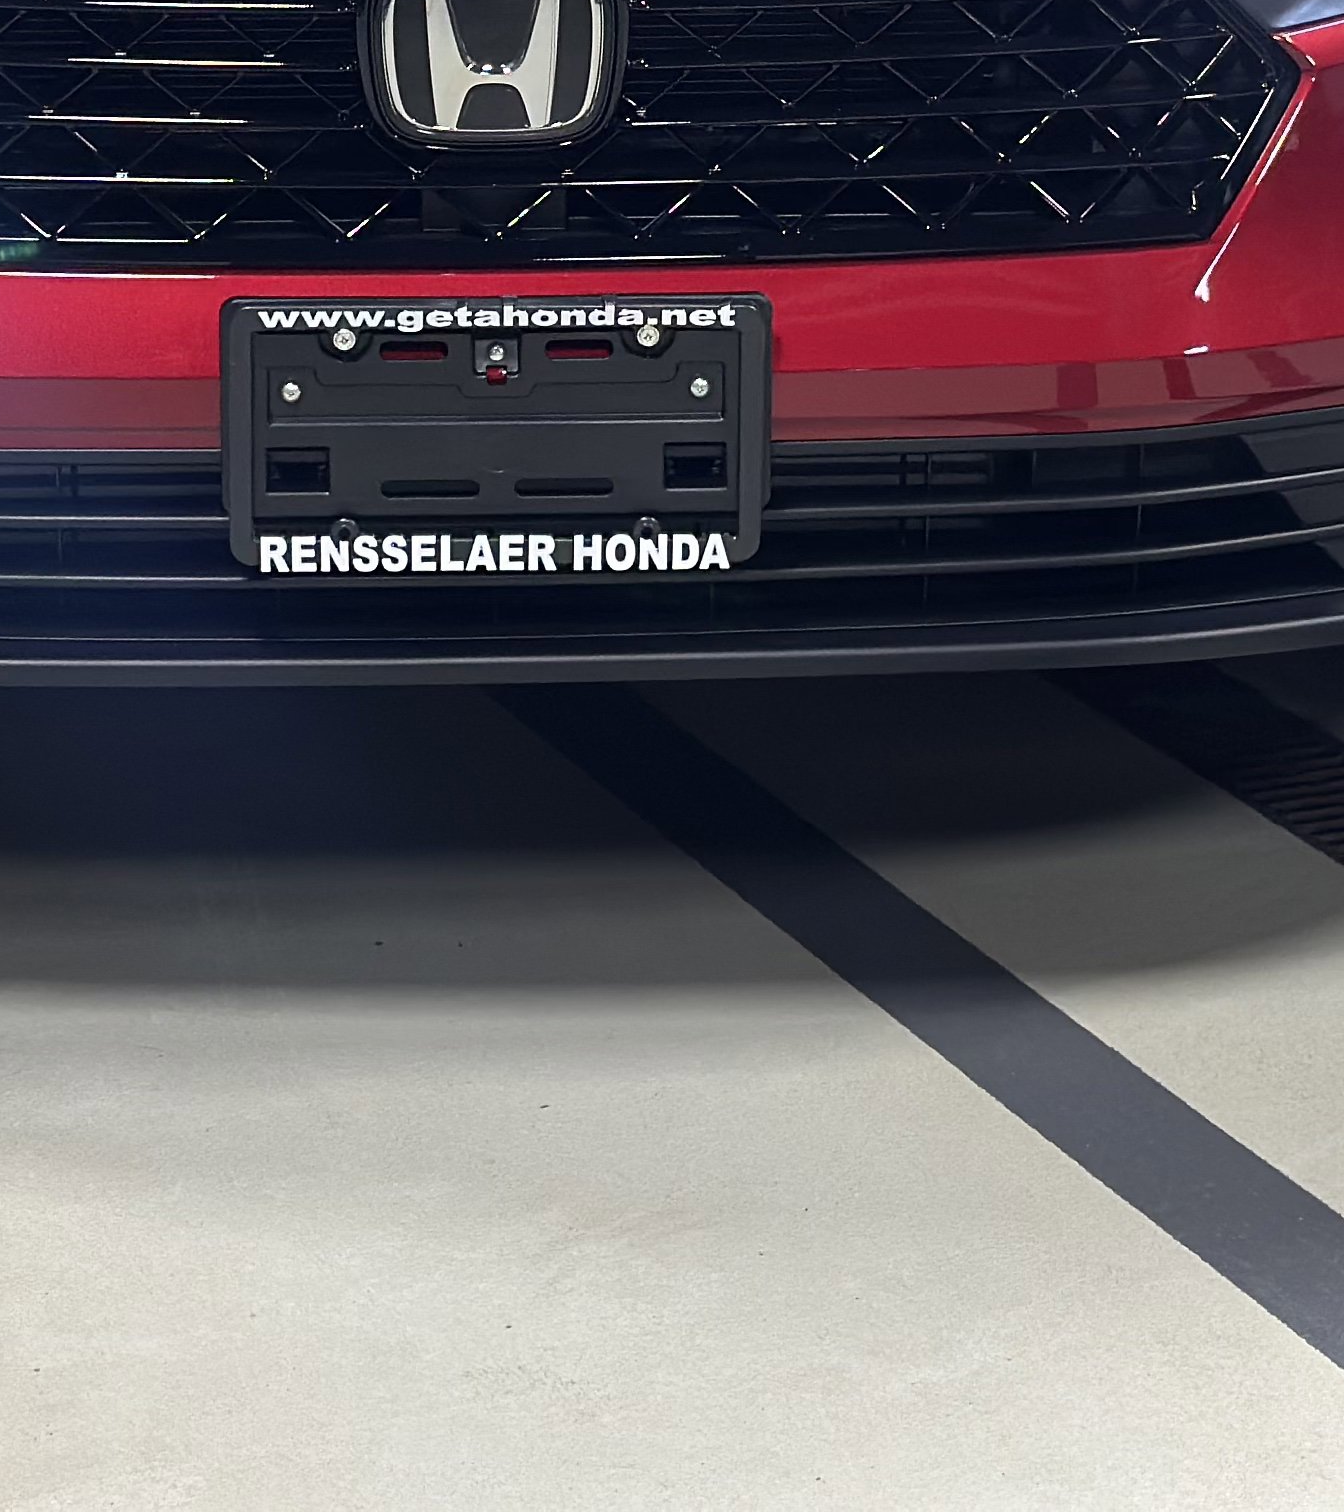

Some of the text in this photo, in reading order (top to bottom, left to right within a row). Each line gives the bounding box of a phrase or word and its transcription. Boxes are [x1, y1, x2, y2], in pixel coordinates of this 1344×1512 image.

[258, 304, 736, 333] www.getahonda.net
[259, 533, 731, 573] RENSSELAER HONDA
